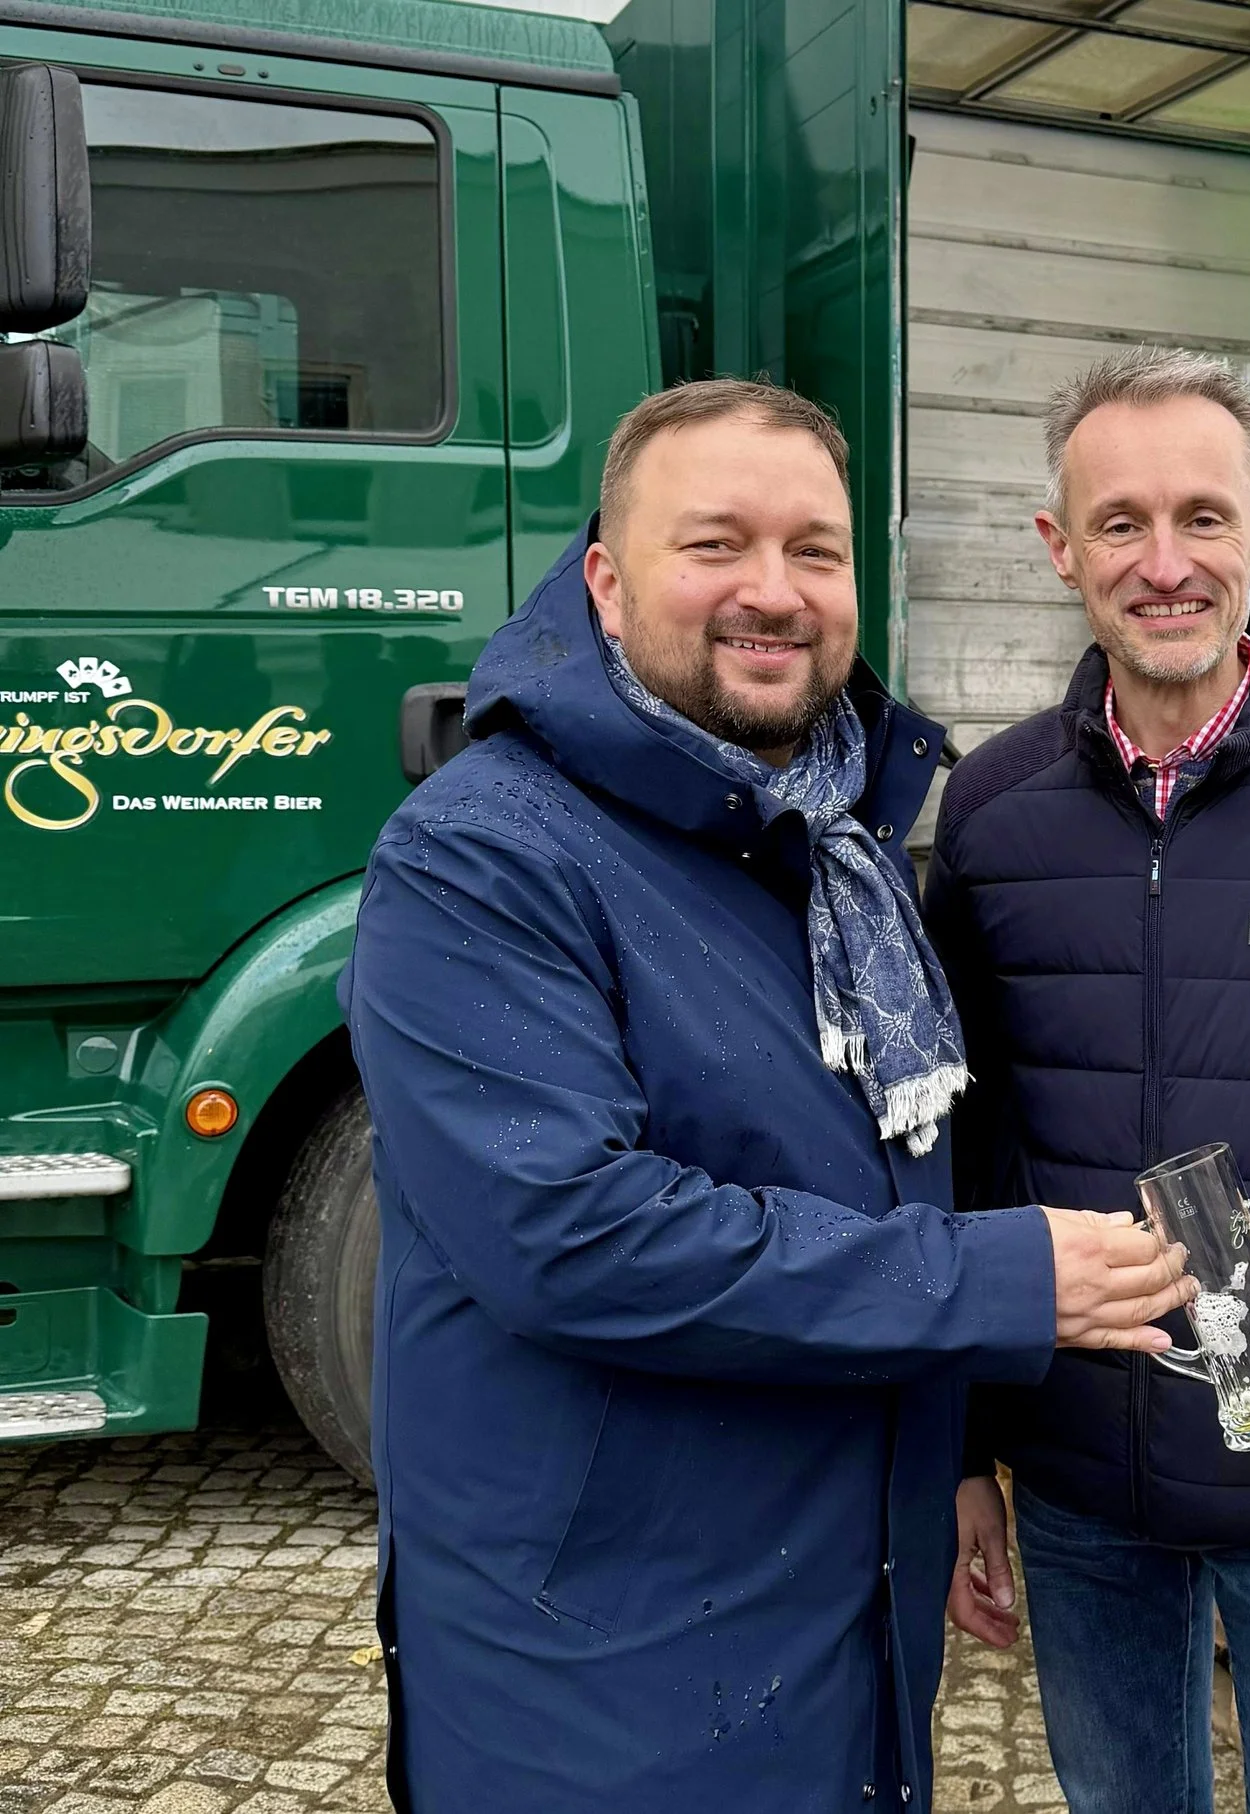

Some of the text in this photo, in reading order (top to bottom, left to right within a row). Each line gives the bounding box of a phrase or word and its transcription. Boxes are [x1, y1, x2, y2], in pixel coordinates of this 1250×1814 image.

[262, 586, 464, 611] TGM 18.320
[0, 691, 91, 704] RUMPF IST
[0, 699, 332, 831] ingsdorfer
